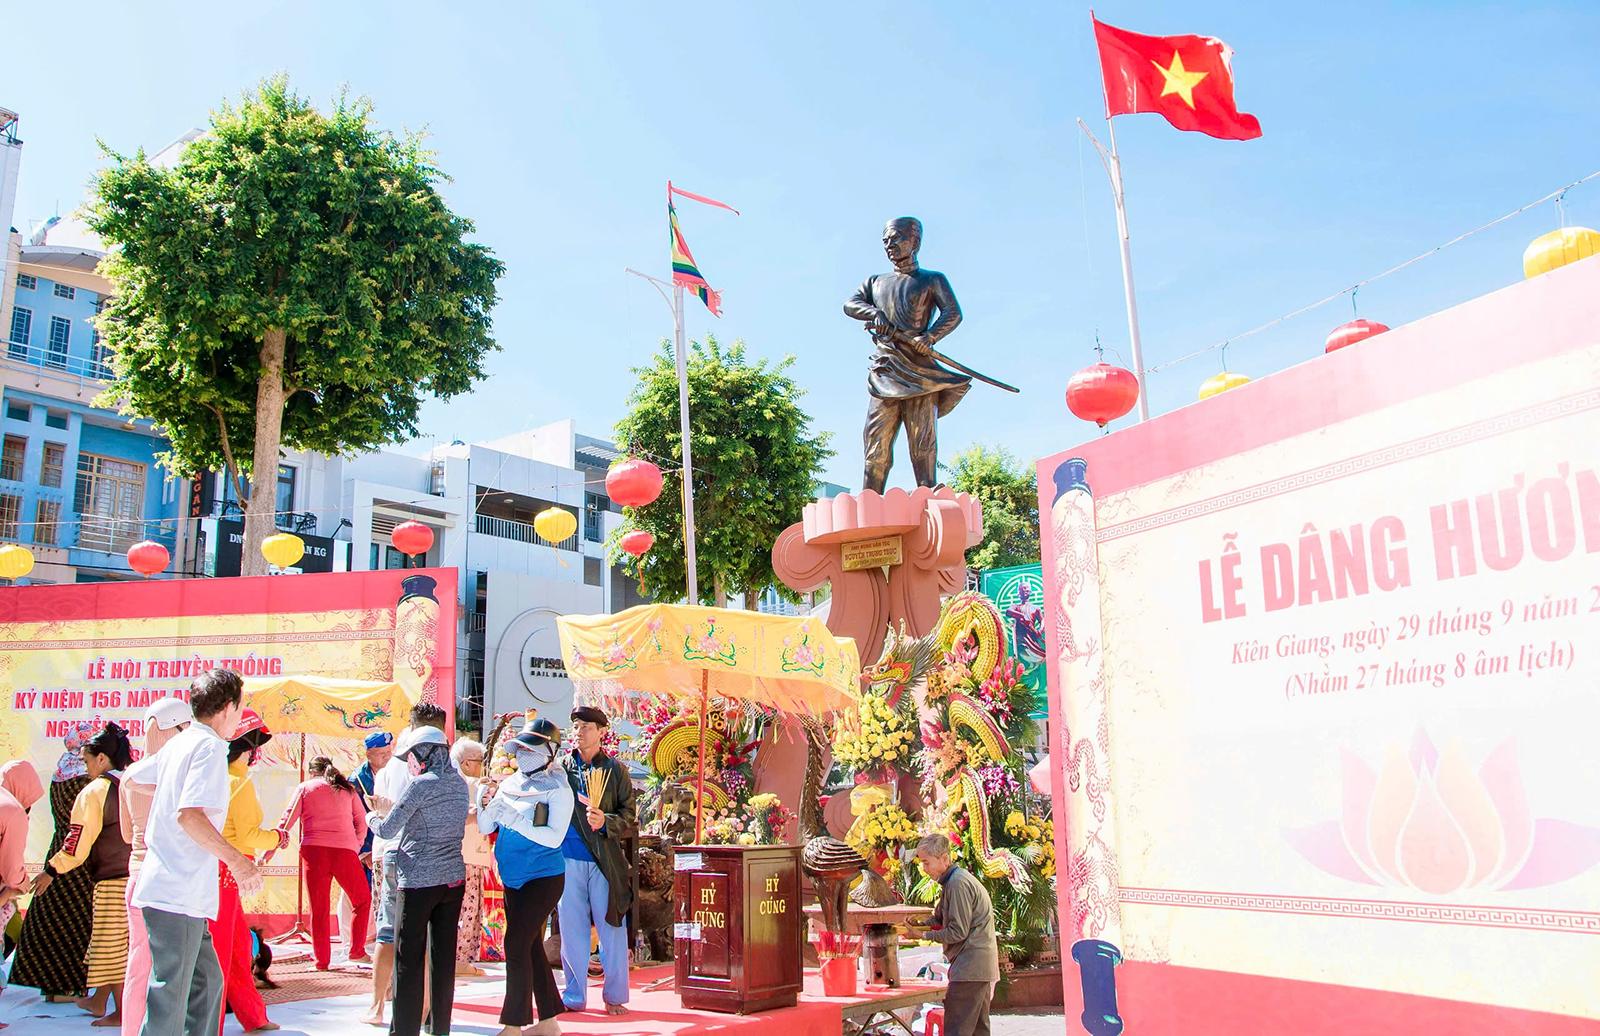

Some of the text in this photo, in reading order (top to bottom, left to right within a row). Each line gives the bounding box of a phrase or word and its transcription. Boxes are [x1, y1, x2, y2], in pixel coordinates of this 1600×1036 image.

[313, 547, 327, 557] KG
[1199, 532, 1246, 624] LỄ
[1260, 515, 1411, 613] DÂNG
[1232, 640, 1269, 664] Kiên
[1276, 634, 1335, 658] Giang,
[1343, 621, 1390, 652] ngày
[1396, 614, 1420, 640] 29
[1428, 607, 1493, 636] tháng
[1501, 599, 1514, 625] 9
[1523, 595, 1578, 622] năm
[87, 653, 282, 682] LỄ HỘI TRUYỀN THỐNG
[1285, 640, 1575, 701] (Nhằm 27 tháng 8 âm lịch)
[15, 688, 37, 709] KỶ
[41, 689, 84, 712] NIỆM
[89, 690, 121, 708] 156
[127, 688, 166, 708] NĂM
[694, 907, 725, 928] CÚNG
[759, 896, 786, 915] CÚNG
